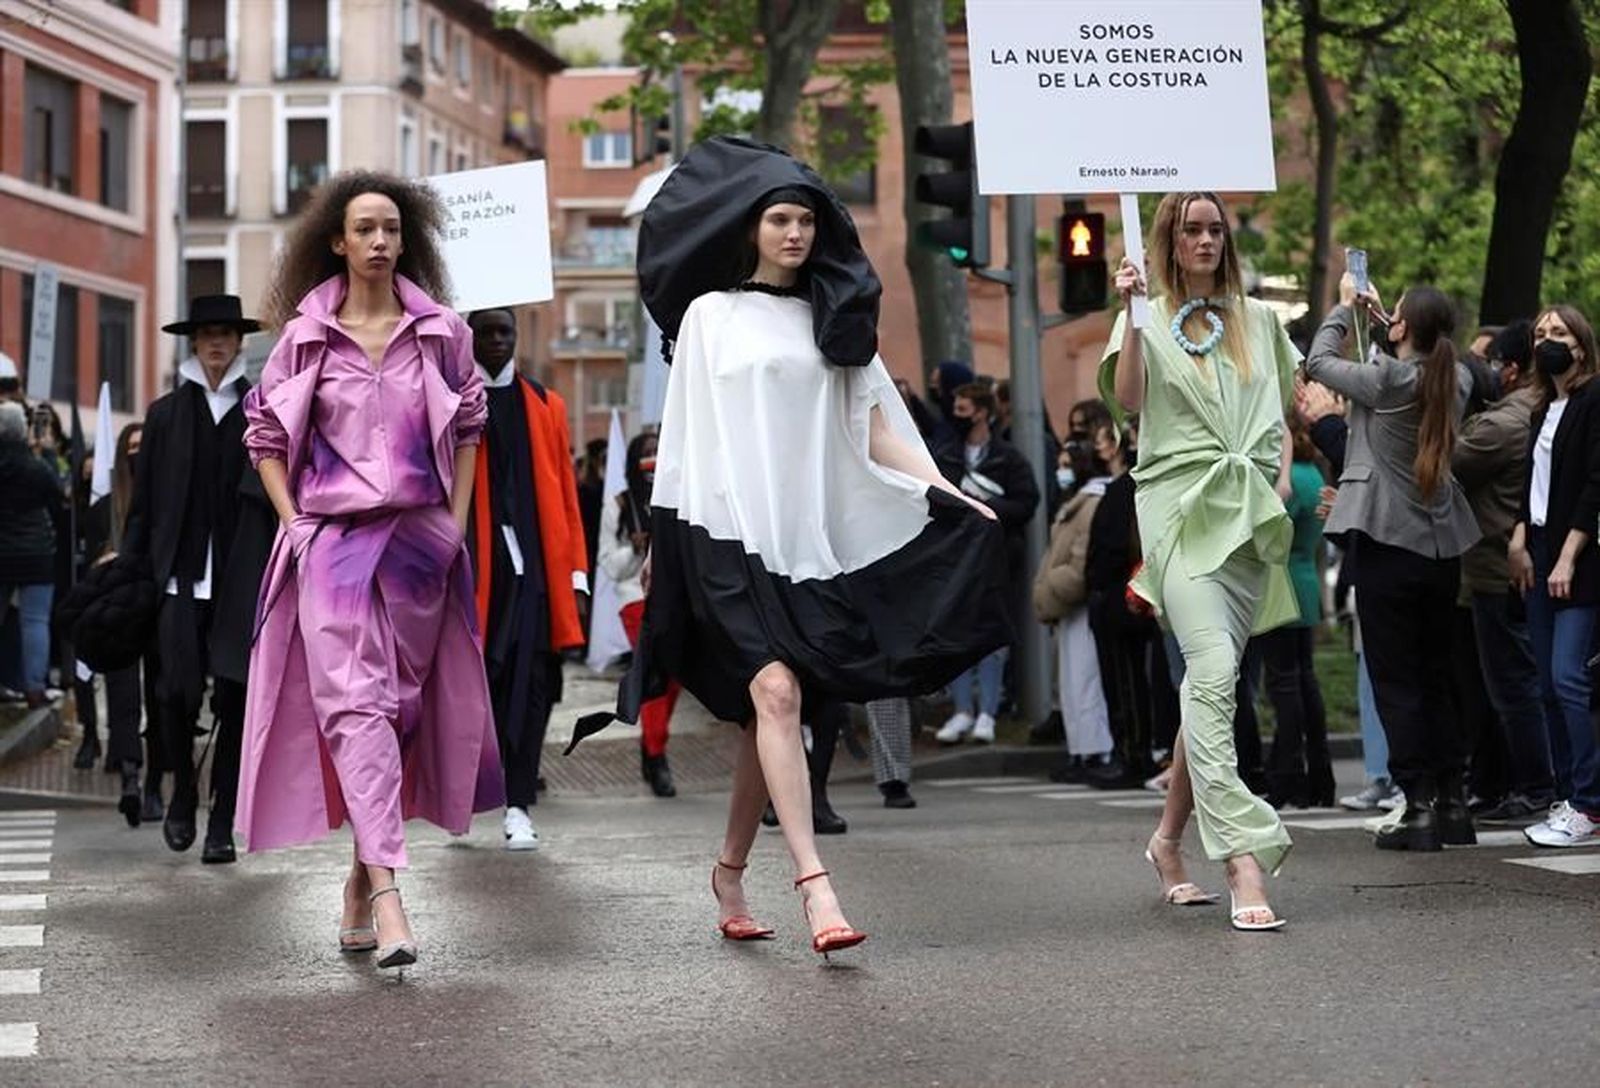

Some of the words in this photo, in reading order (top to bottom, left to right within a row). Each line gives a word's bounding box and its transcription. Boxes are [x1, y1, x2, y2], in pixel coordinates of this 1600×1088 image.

[1079, 24, 1154, 40] SOMOS
[991, 48, 1018, 65] LA
[1026, 48, 1099, 65] NUEVA
[1106, 45, 1243, 64] GENERACIÓN
[1038, 72, 1067, 89] DE
[1073, 72, 1102, 88] LA
[1109, 71, 1208, 88] COSTURA
[1079, 167, 1127, 178] Ernesto
[1131, 166, 1179, 178] Naranjo
[461, 203, 516, 221] RAZÓN
